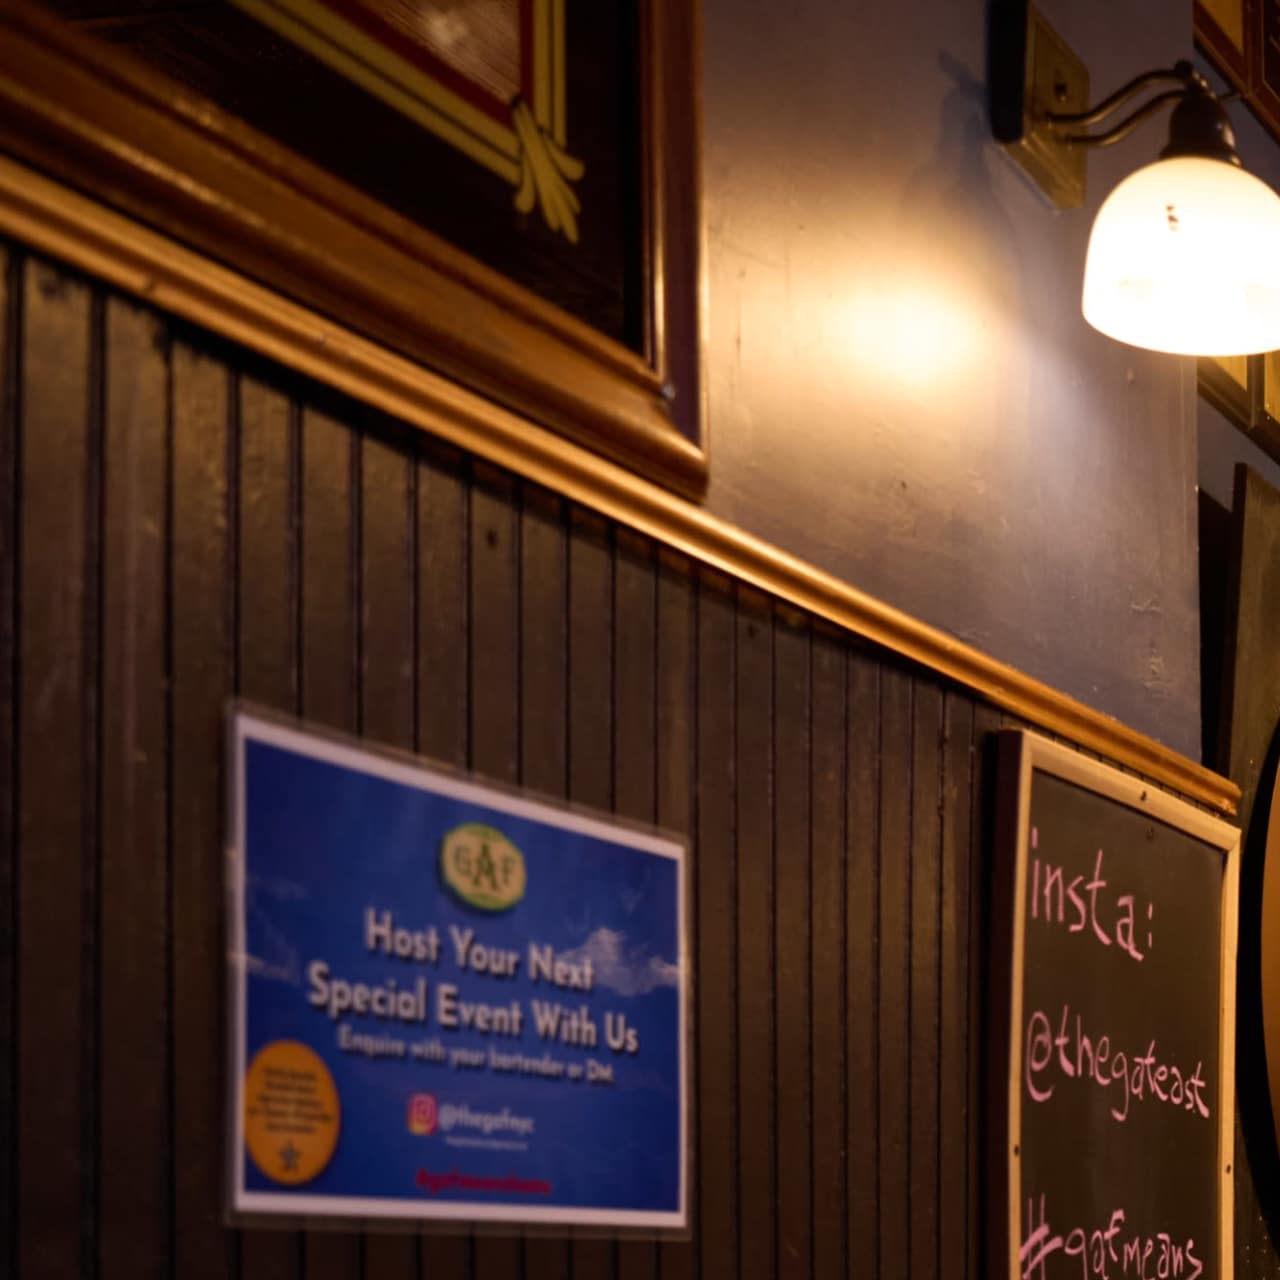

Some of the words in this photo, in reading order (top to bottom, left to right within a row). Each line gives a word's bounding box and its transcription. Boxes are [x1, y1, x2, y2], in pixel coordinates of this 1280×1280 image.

[455, 843, 515, 890] GAF
[1031, 826, 1153, 961] insta:
[365, 907, 440, 962] Host
[450, 926, 520, 976] Your
[529, 944, 594, 989] Next
[307, 961, 426, 1018] Special
[436, 984, 522, 1033] Event
[531, 998, 597, 1045] With
[605, 1012, 638, 1052] Us
[410, 1037, 446, 1061] with
[450, 1046, 485, 1069] your
[489, 1047, 564, 1077] bartender
